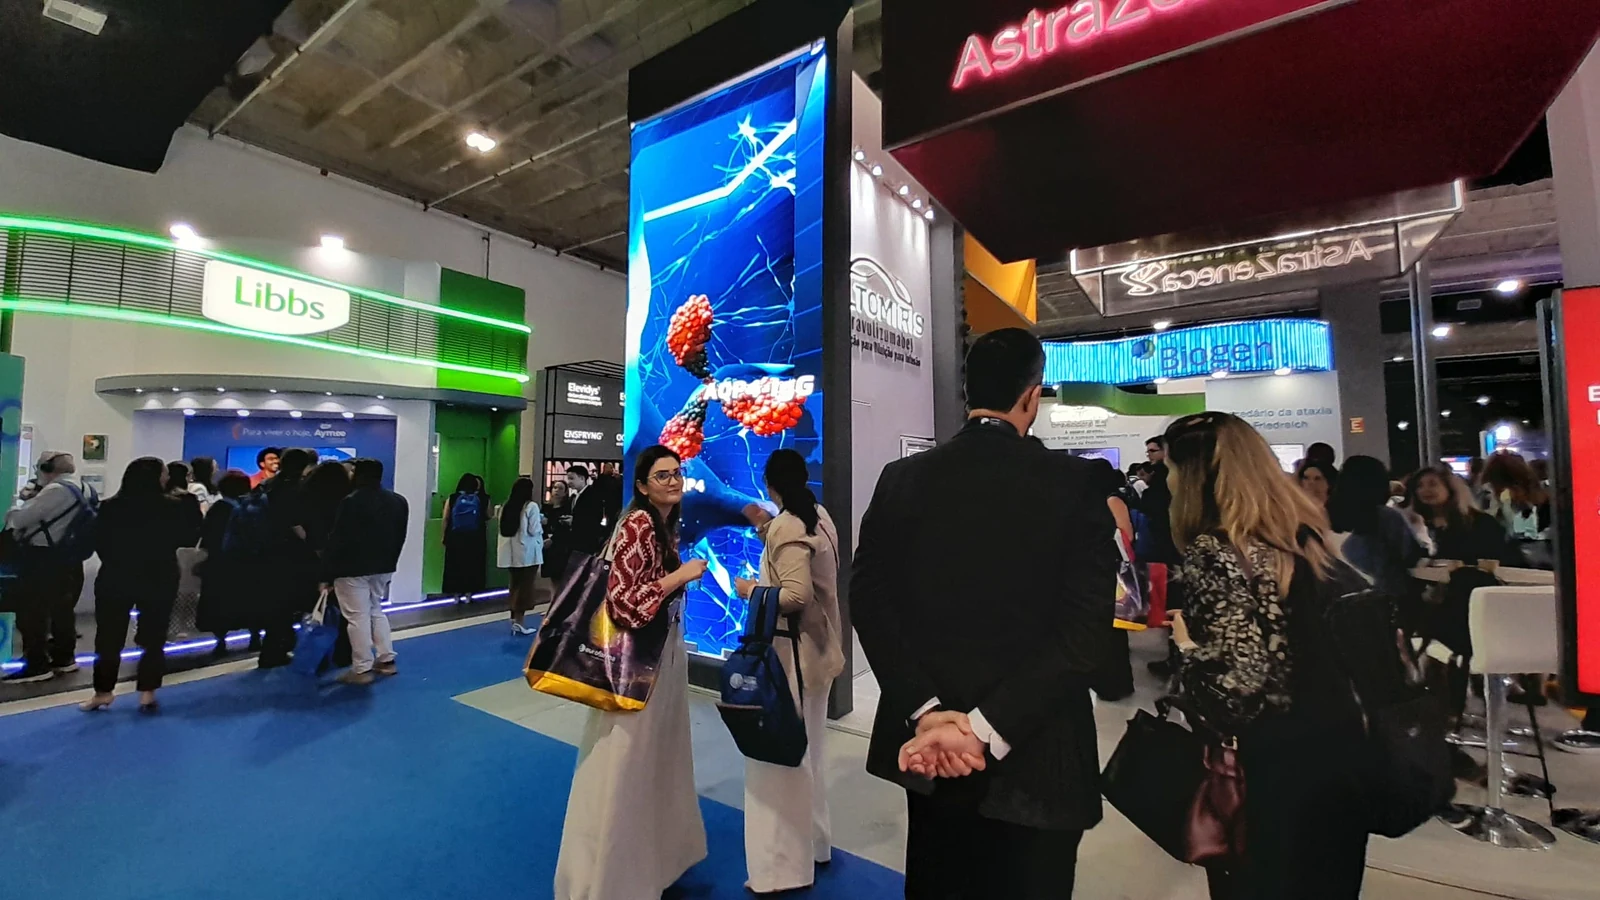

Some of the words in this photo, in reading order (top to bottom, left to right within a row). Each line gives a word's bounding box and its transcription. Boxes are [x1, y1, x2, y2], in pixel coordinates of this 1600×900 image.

[235, 275, 325, 320] Libbs
[1160, 341, 1274, 372] Biogen
[1278, 408, 1292, 417] da
[1296, 407, 1333, 416] ataxia
[242, 428, 262, 436] Para
